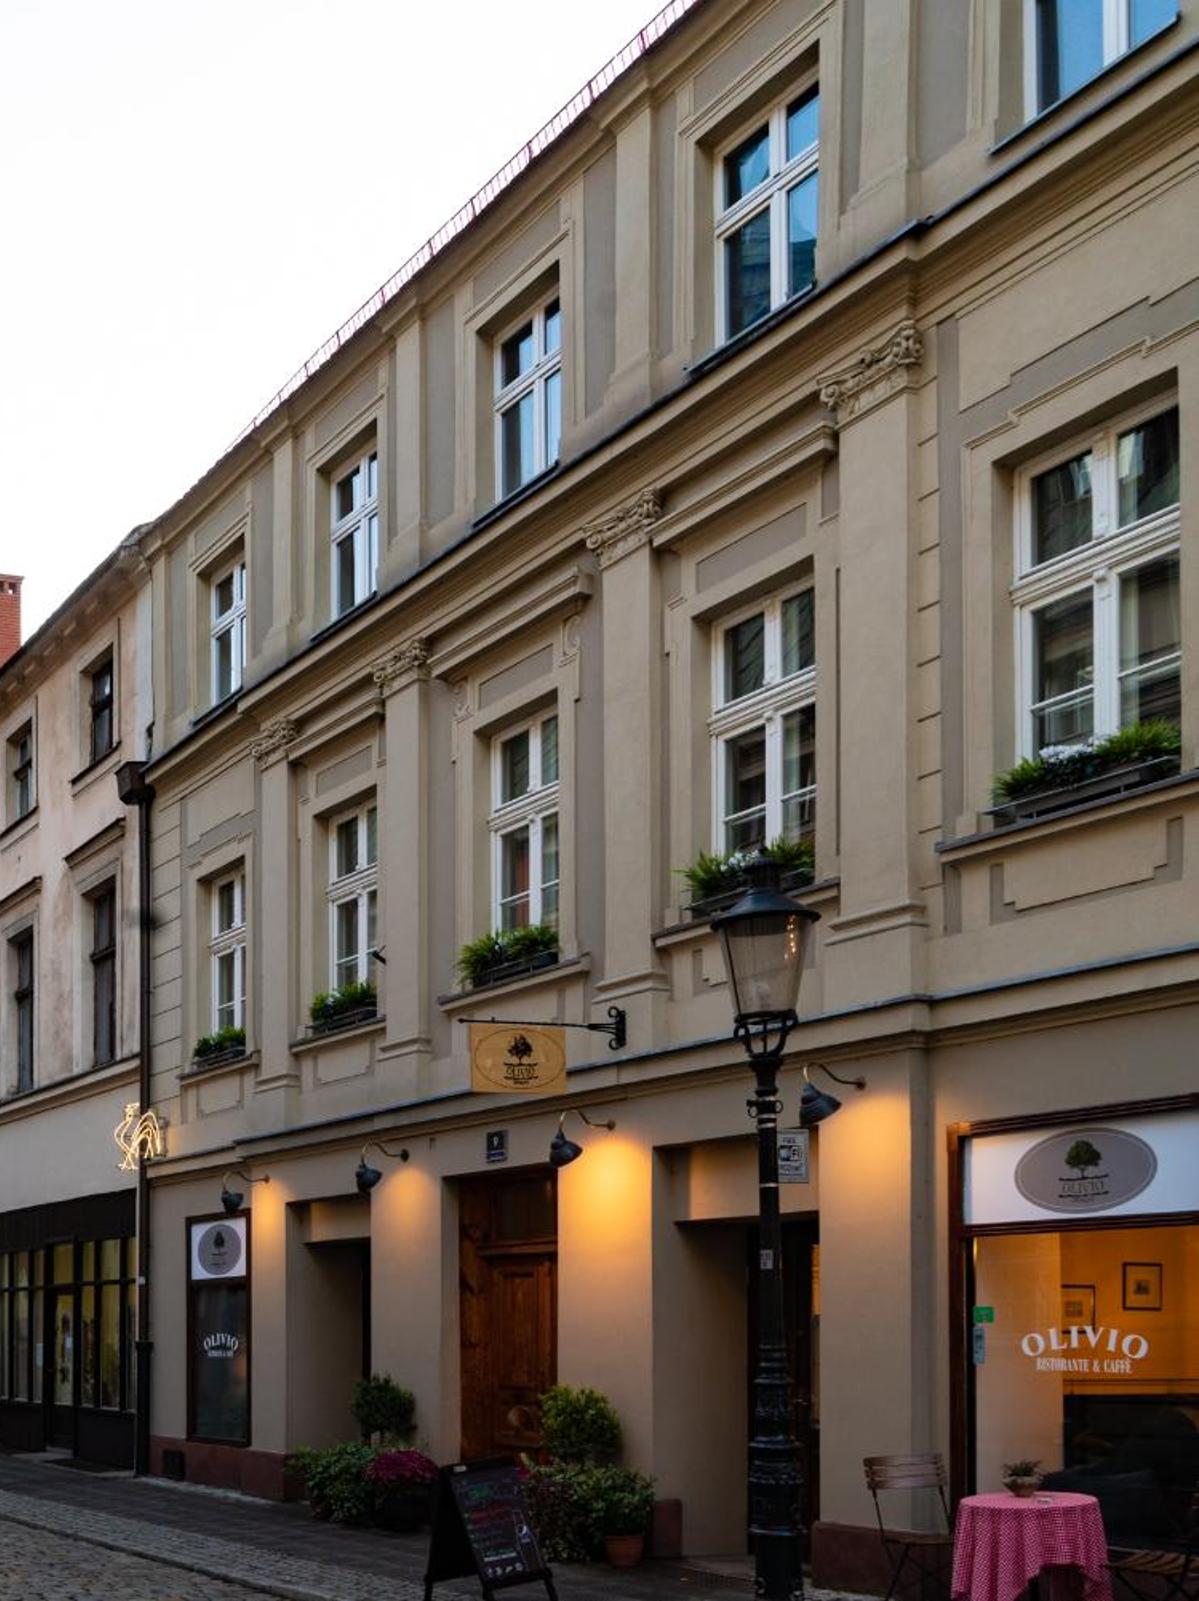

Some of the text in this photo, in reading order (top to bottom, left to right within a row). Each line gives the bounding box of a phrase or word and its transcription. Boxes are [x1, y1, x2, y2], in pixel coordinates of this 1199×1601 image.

[1062, 1179, 1104, 1193] OLIVIO
[203, 1333, 239, 1351] OLIVIO
[1021, 1325, 1149, 1359] OLIVIO
[1036, 1357, 1089, 1373] RISTORANTE
[1092, 1360, 1101, 1373] &
